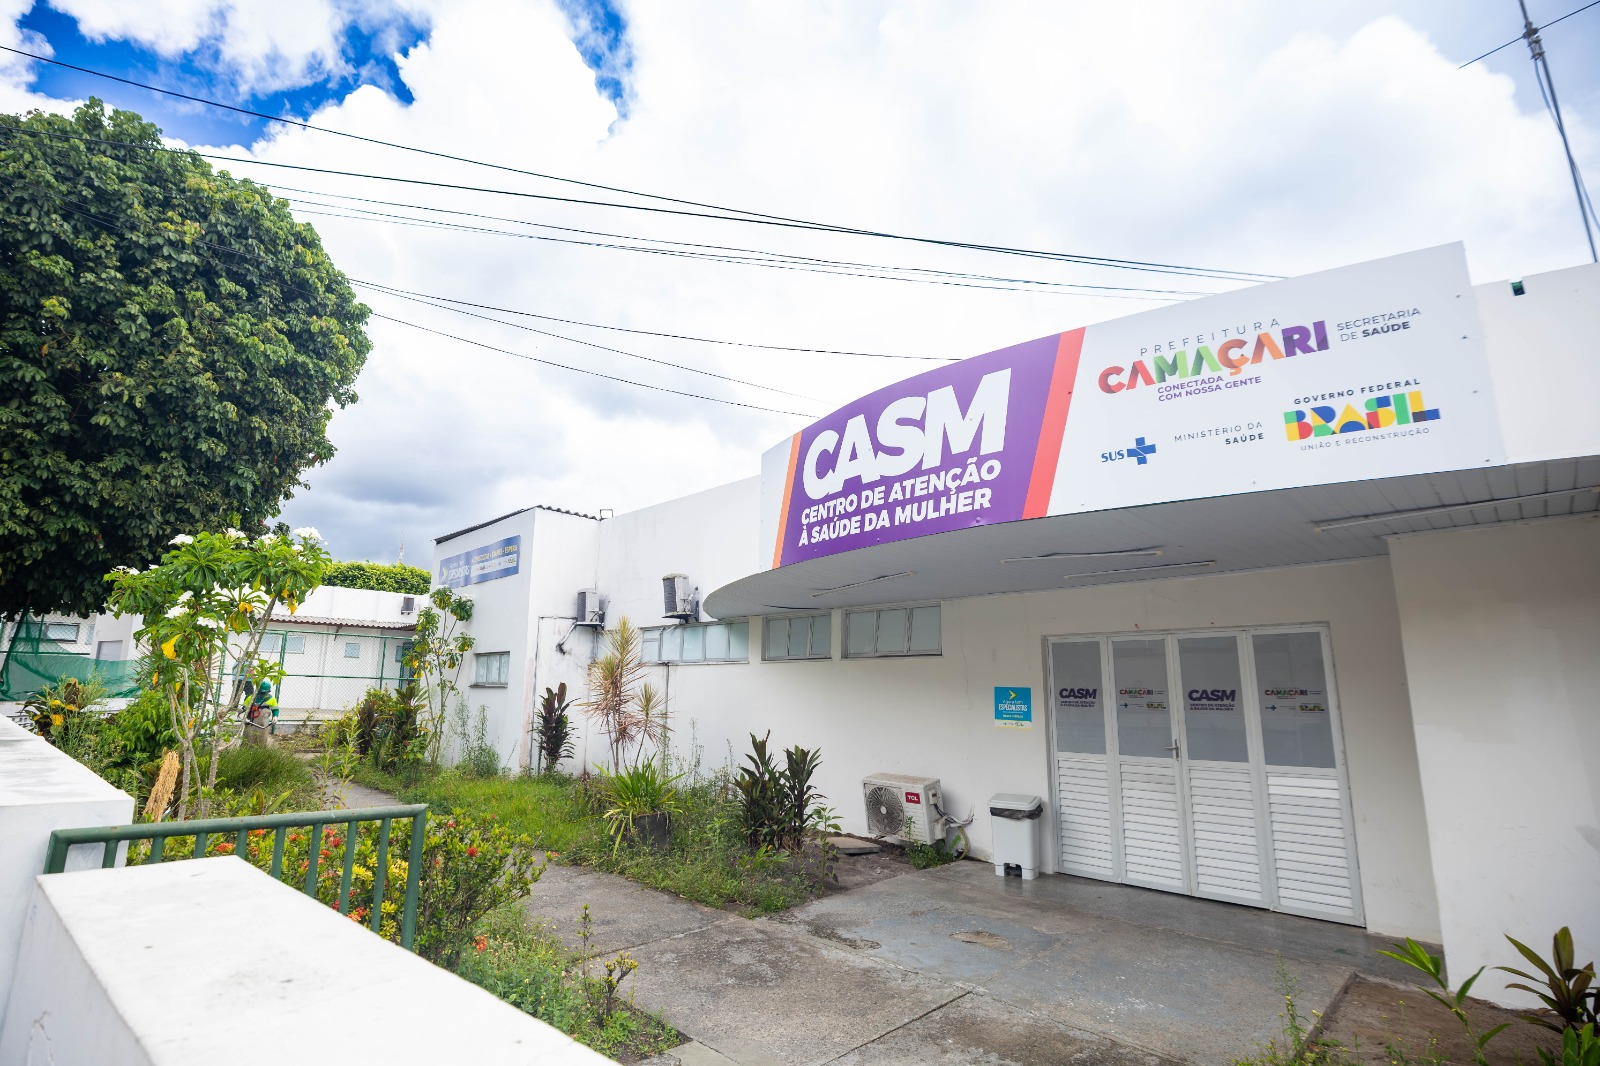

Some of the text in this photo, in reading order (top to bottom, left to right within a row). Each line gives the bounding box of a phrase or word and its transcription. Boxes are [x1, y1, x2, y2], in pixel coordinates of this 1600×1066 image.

[1336, 307, 1421, 331] SECRETARIA
[1340, 321, 1411, 342] DE SAÚDE
[1140, 318, 1280, 356] PREFEITURA
[1098, 320, 1331, 394] CAMAÇARI
[1157, 375, 1224, 394] CONECTADA
[1158, 376, 1262, 402] COM NOSSA GENTE
[1294, 378, 1421, 405] GOVERNO FEDERAL
[1283, 390, 1441, 442] BRASIL
[802, 367, 1012, 500] CASM
[1174, 421, 1263, 442] MINISTÉRIO DA
[1225, 432, 1264, 445] SAÚDE
[1300, 441, 1332, 452] UNIÃO
[1345, 427, 1430, 445] RECONSTRUÇÃO
[1101, 449, 1125, 463] SUS
[801, 456, 1002, 525] CENTRO DE ATENÇÃO
[798, 487, 992, 547] À SAÚDE DA MULHER
[1058, 688, 1097, 699] CASM
[1188, 689, 1236, 702] CASM
